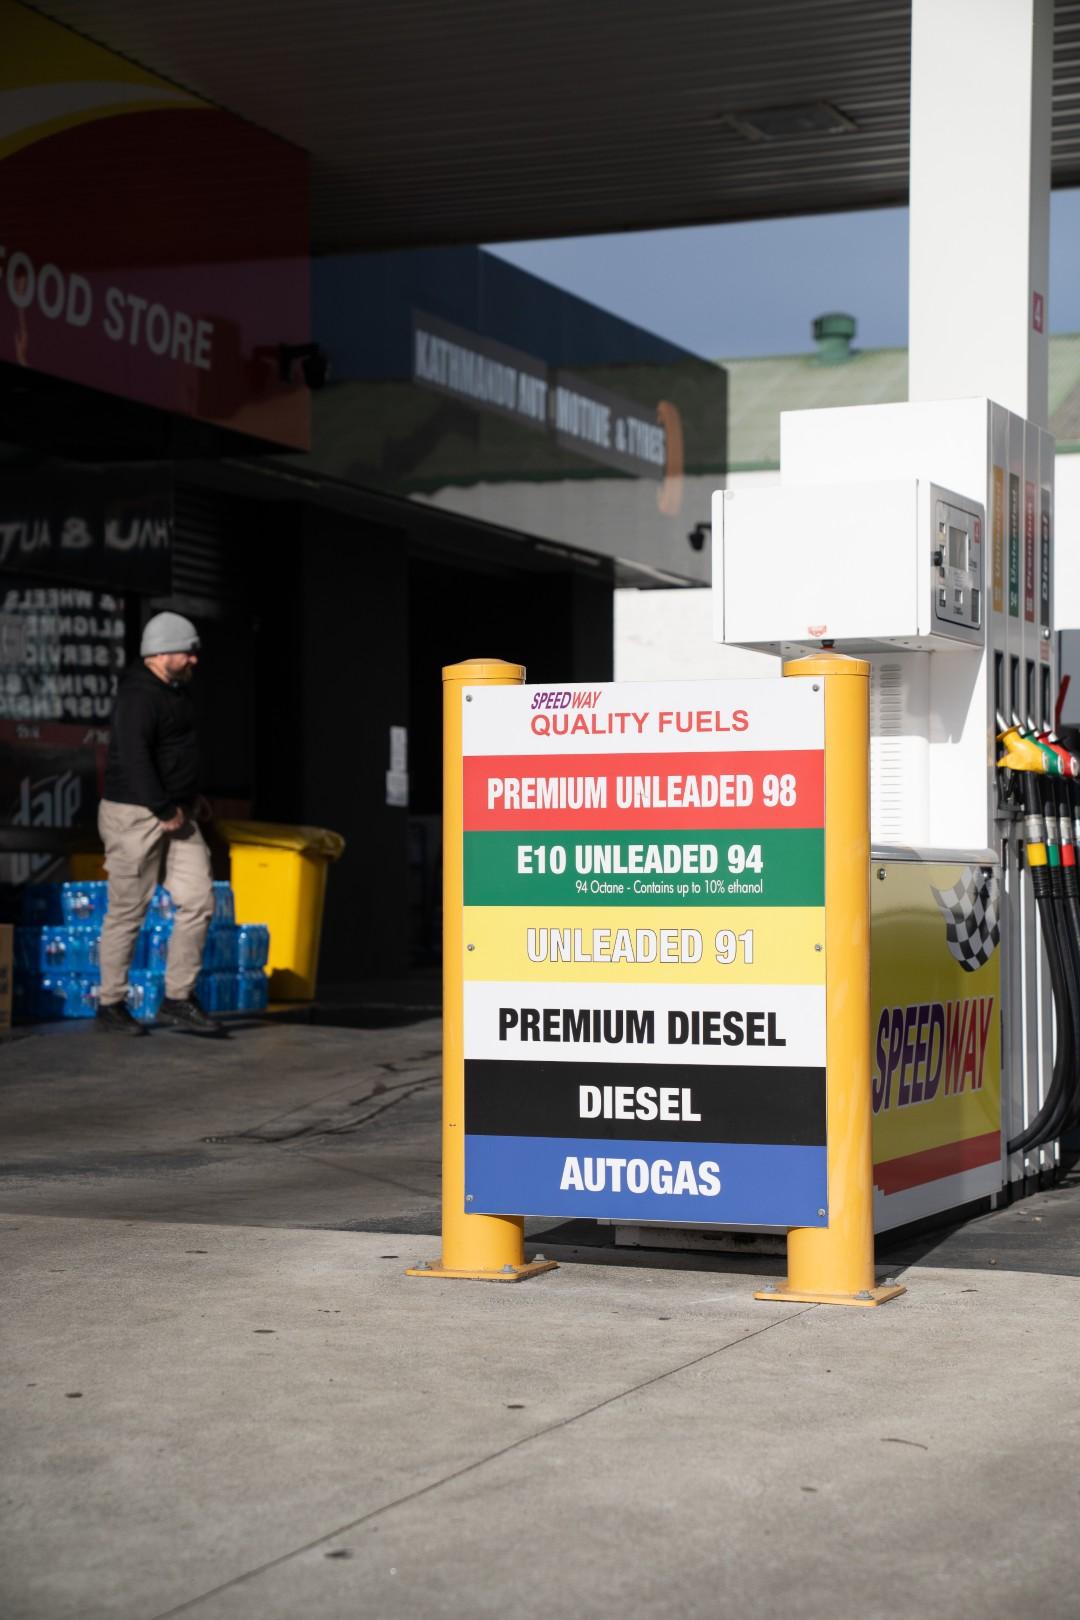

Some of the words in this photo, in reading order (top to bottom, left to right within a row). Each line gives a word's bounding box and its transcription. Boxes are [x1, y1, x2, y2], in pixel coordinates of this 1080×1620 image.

[103, 286, 214, 370] STORE
[531, 691, 602, 710] SPEEDWAY
[531, 712, 650, 737] QUALITY
[658, 709, 750, 733] FUELS
[487, 777, 607, 810] PREMIUM
[616, 775, 754, 809] UNLEADED
[763, 774, 797, 808] 98
[517, 845, 566, 875] E10
[575, 845, 718, 875] UNLEADED
[728, 844, 764, 874] 94
[575, 880, 588, 894] 94
[590, 879, 624, 894] Octane
[633, 880, 674, 894] Contains
[677, 883, 689, 897] up
[692, 881, 701, 894] to
[704, 879, 726, 894] 10%
[728, 879, 763, 894] ethanol
[526, 928, 703, 963] UNLEADED
[714, 929, 754, 964] 91
[499, 1007, 655, 1044] PREMIUM
[667, 1010, 786, 1046] DIESEL
[872, 997, 994, 1115] SPEEDWAY
[579, 1085, 702, 1121] DIESEL
[559, 1156, 722, 1196] AUTOGAS
